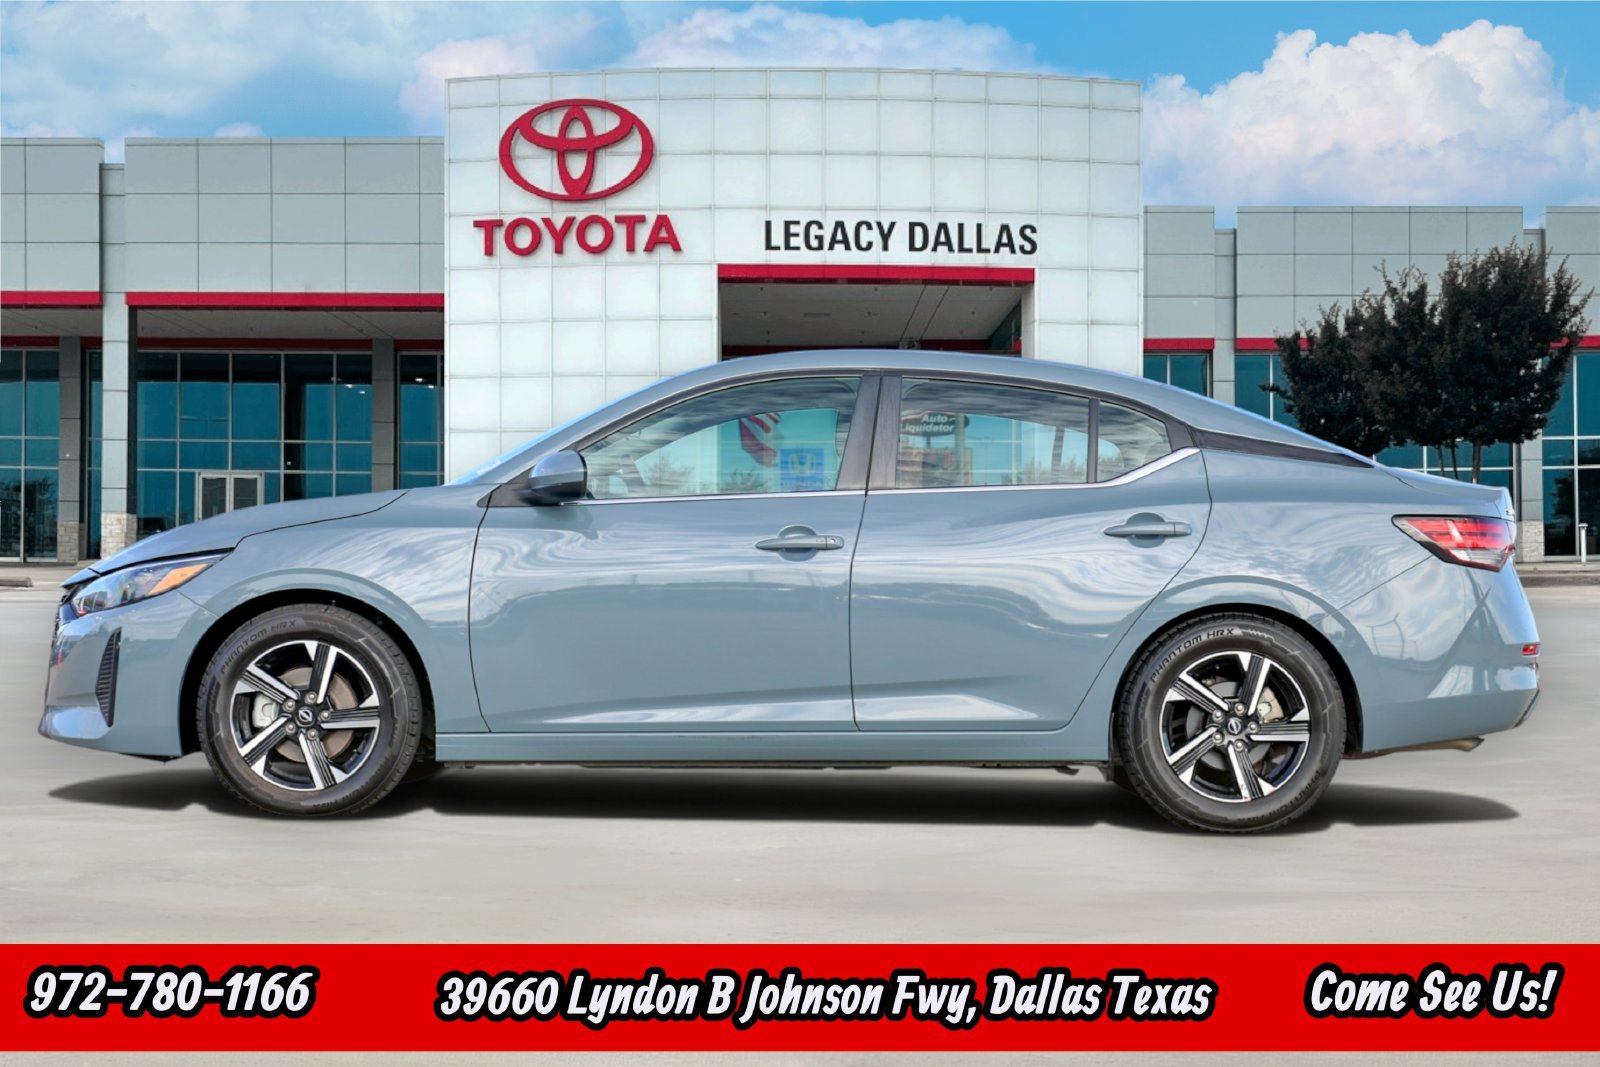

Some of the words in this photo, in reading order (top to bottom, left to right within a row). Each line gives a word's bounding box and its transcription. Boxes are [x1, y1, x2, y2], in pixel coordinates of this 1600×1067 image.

[474, 214, 681, 257] TOYOTA
[764, 220, 897, 252] LEGACY
[908, 221, 1038, 256] DALLAS
[921, 414, 948, 423] Auto
[221, 628, 268, 675] PHANTOM
[270, 619, 297, 632] HRX
[1150, 634, 1202, 683] PHANTOM
[1206, 627, 1234, 638] HRX
